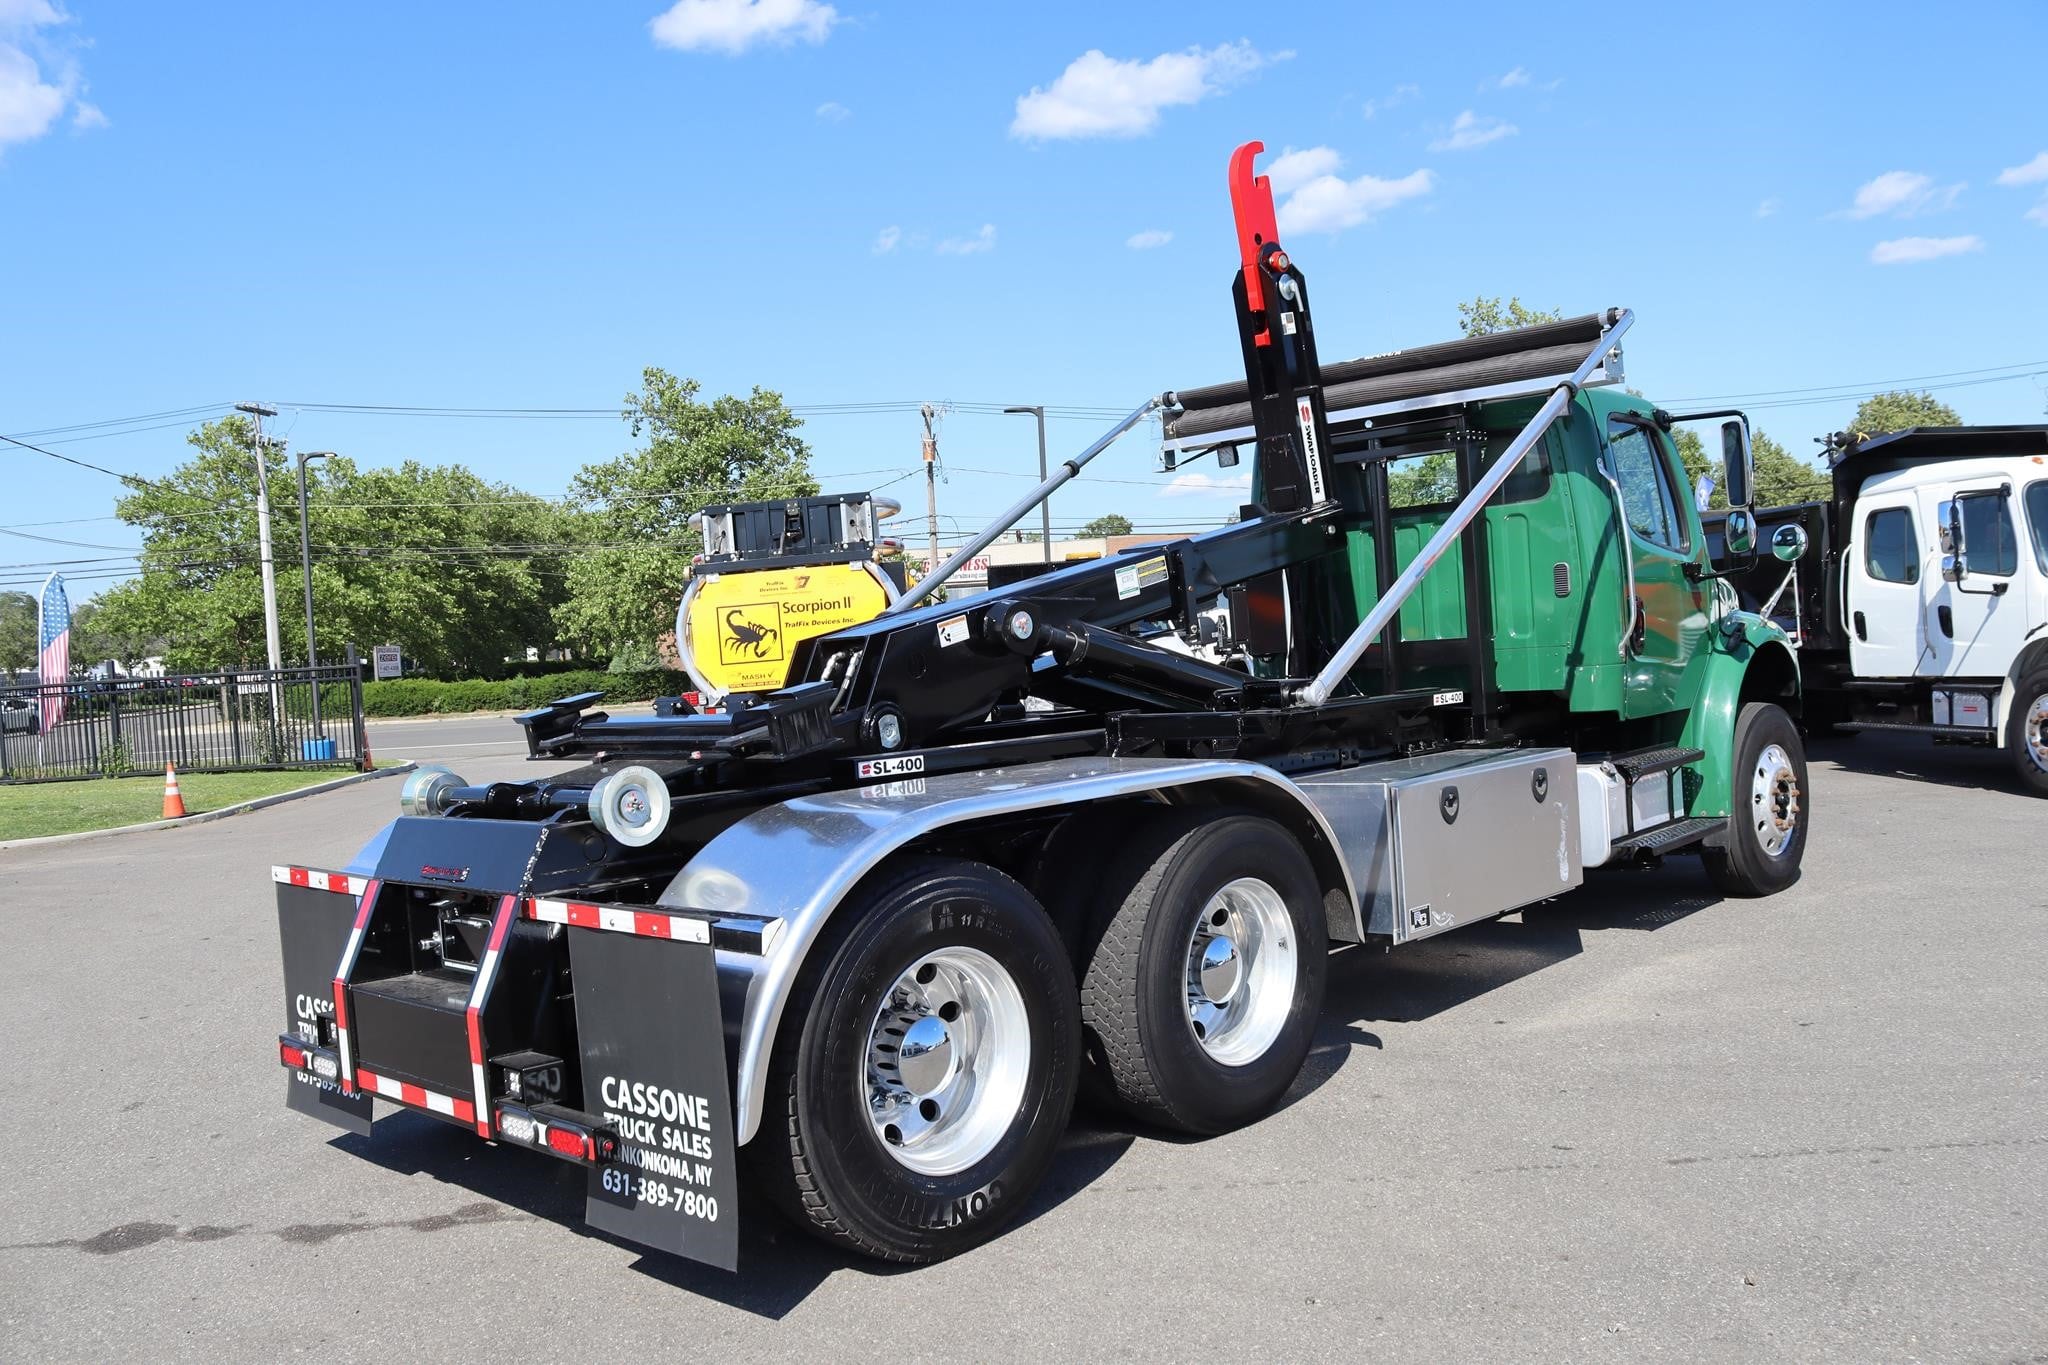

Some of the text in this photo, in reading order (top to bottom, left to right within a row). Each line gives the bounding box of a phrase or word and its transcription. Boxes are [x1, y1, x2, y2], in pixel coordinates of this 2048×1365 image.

[1304, 425, 1321, 494] SWAPLOADER
[782, 598, 840, 615] Scorpion
[811, 618, 841, 627] Devices
[601, 1076, 711, 1132] CASSONE
[662, 1127, 713, 1160] SALES
[695, 1163, 713, 1187] NY
[602, 1168, 718, 1222] 631-389-7800
